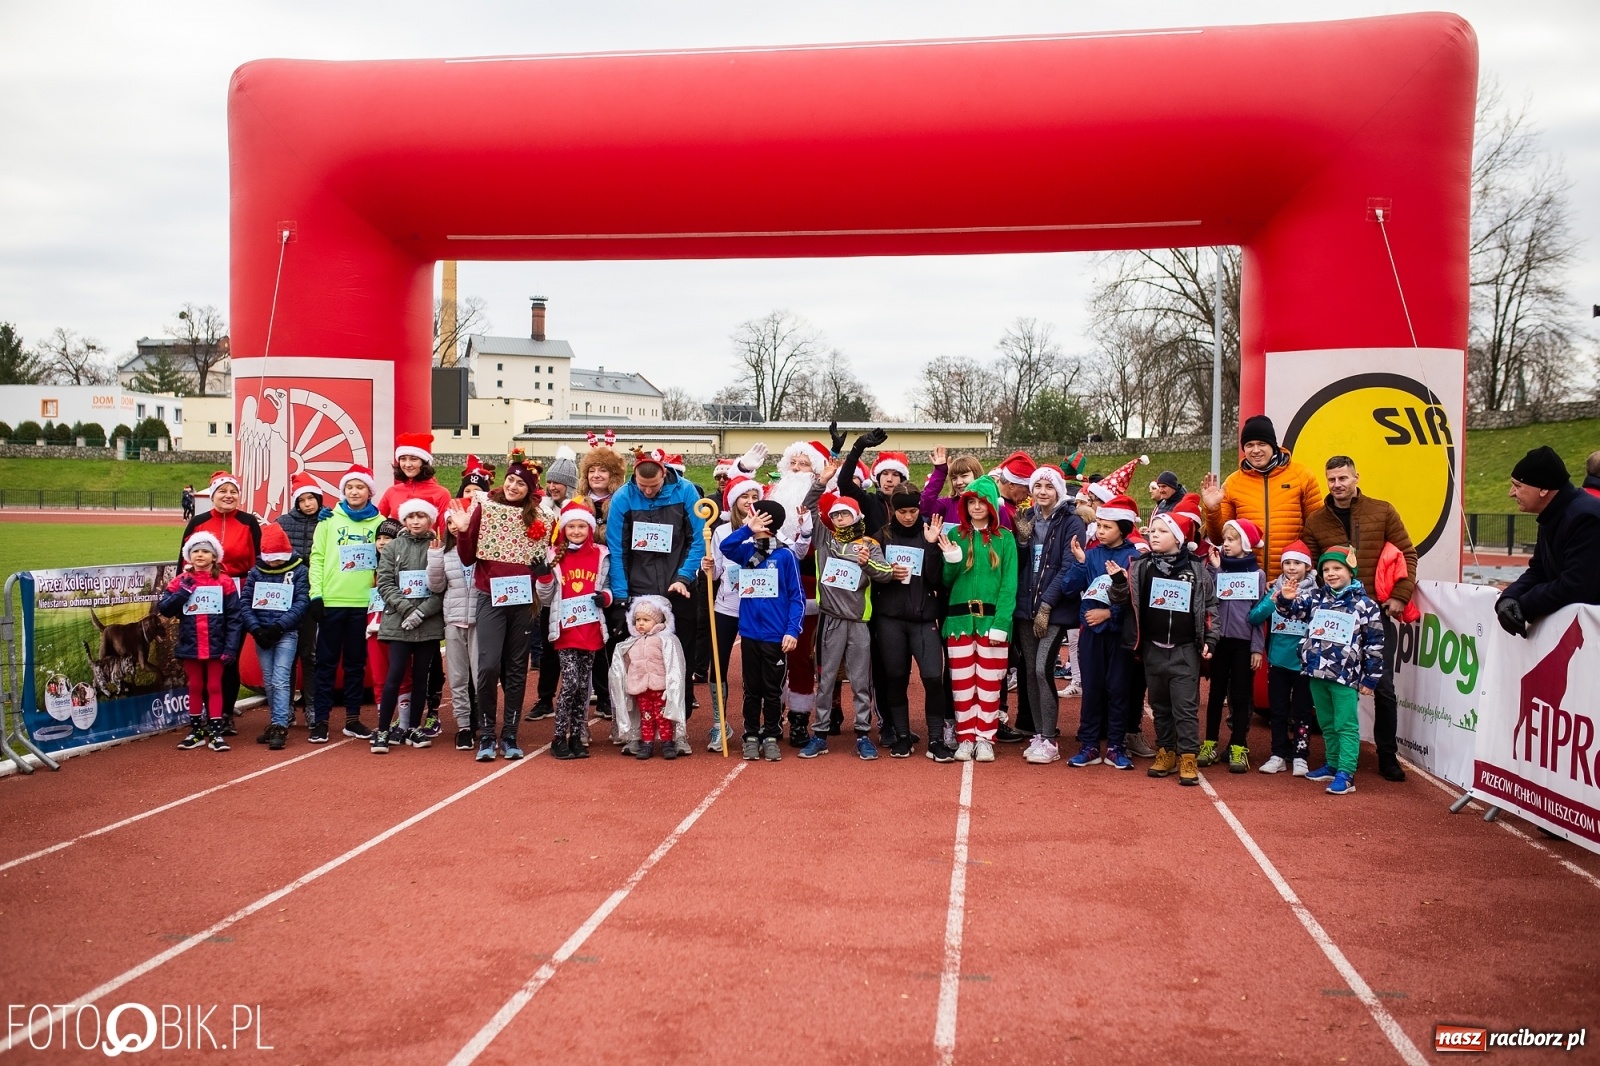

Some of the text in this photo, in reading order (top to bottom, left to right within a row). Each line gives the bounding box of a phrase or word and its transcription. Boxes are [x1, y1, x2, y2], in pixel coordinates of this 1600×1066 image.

[92, 395, 114, 405] DOM
[1372, 406, 1454, 446] SIR
[645, 532, 659, 541] 175
[352, 552, 366, 561] 147
[896, 554, 911, 563] 009
[835, 568, 849, 578] 210
[37, 571, 145, 595] Przez kolejne pory roku
[751, 578, 766, 587] 032
[1229, 580, 1246, 590] 005
[504, 585, 519, 595] 135
[1162, 589, 1180, 599] 025
[195, 595, 210, 604] 041
[265, 591, 281, 600] 060
[572, 604, 587, 615] 008
[1323, 619, 1340, 631] 021
[1480, 770, 1513, 795] PRZECIW
[1543, 798, 1548, 811] I
[1547, 799, 1596, 834] KLESZCZOM
